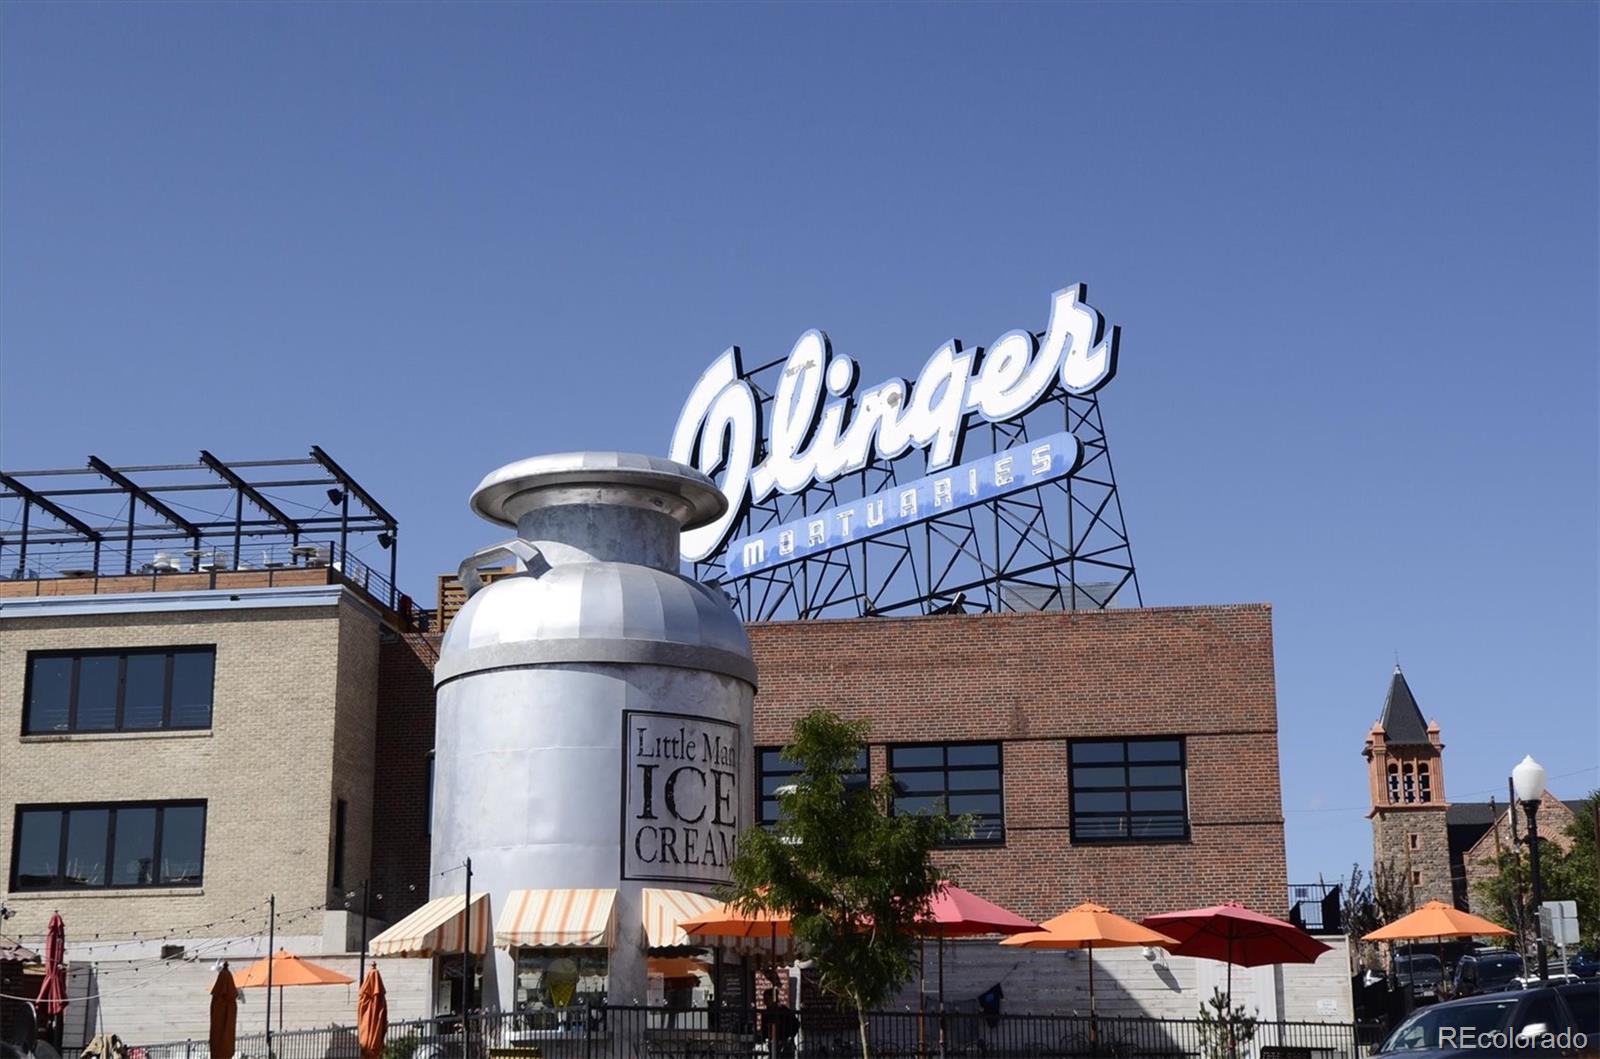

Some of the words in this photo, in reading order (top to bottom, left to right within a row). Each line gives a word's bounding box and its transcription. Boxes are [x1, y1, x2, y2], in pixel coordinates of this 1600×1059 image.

[670, 283, 1120, 562] Olinger
[743, 444, 1051, 566] MORTUARIES
[636, 728, 696, 760] Little
[702, 733, 736, 768] Man
[636, 764, 736, 827] ICE
[635, 826, 736, 867] CREAM
